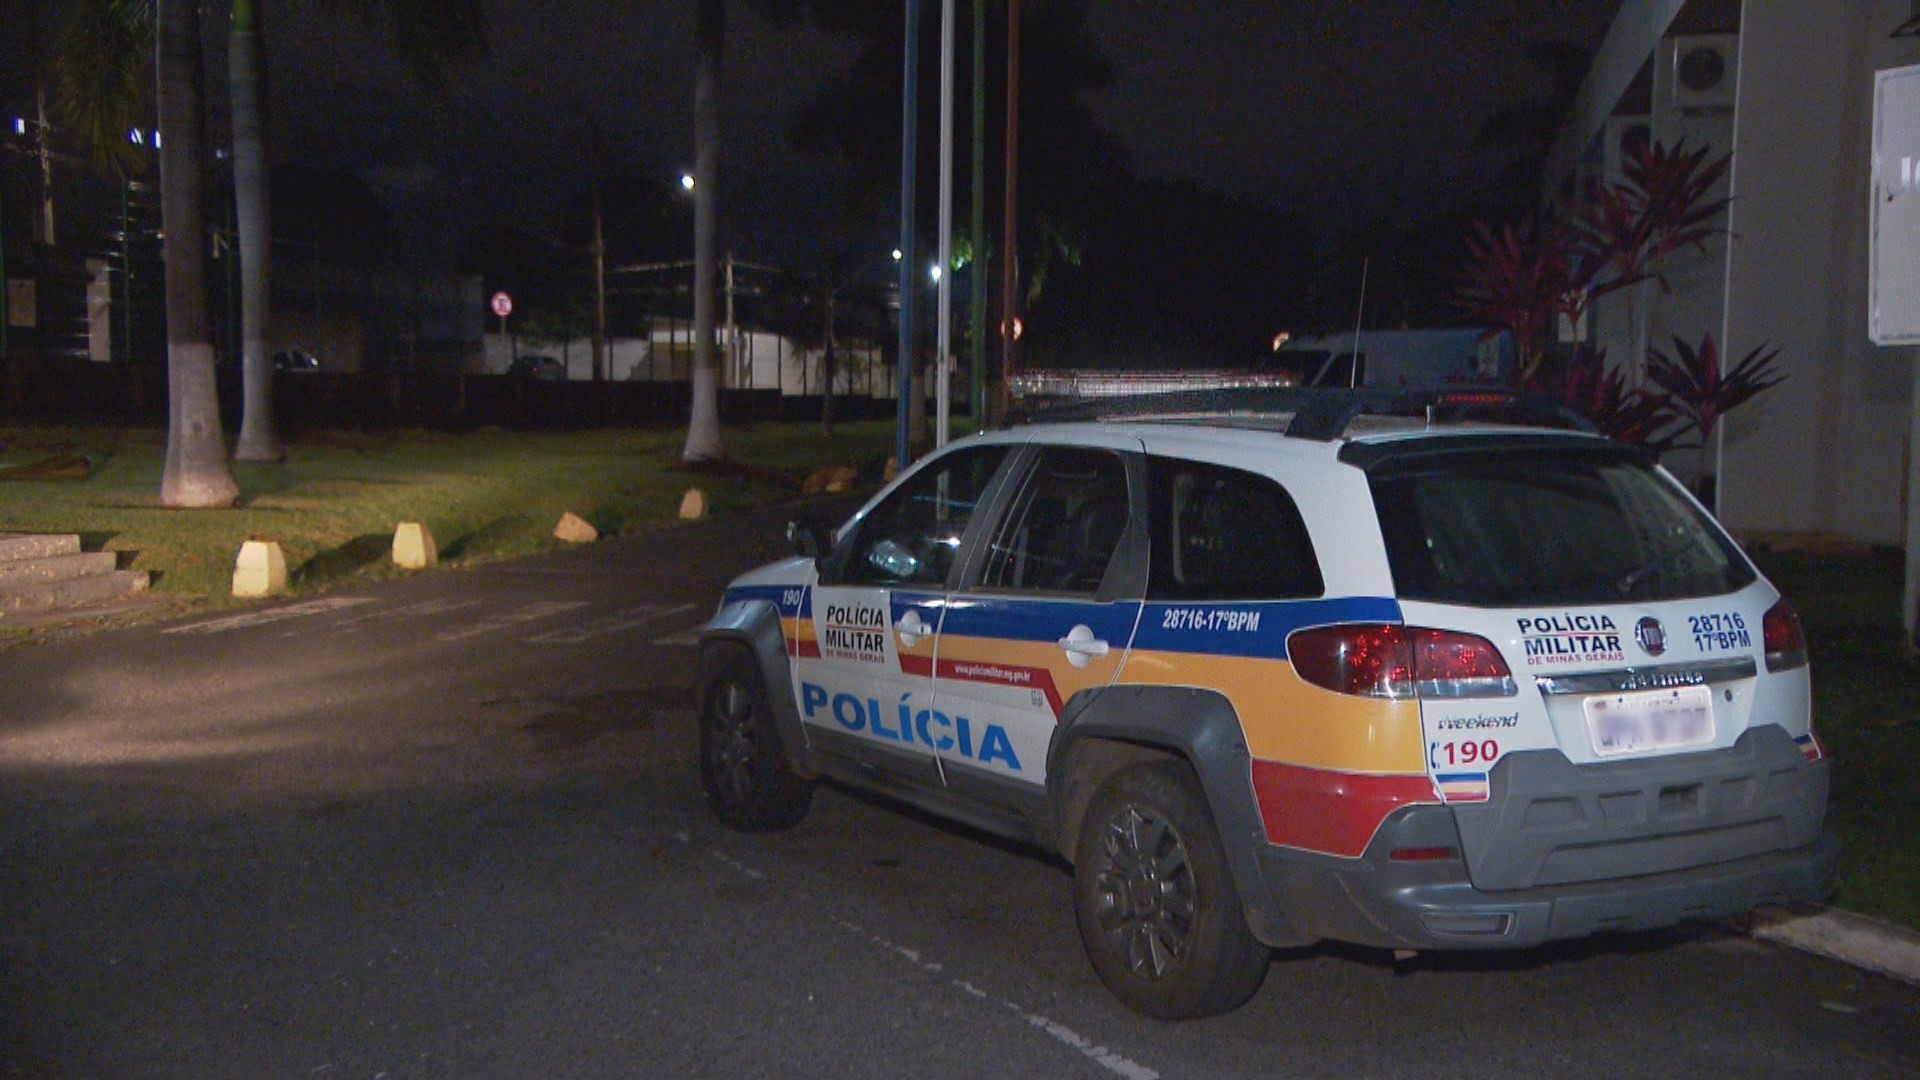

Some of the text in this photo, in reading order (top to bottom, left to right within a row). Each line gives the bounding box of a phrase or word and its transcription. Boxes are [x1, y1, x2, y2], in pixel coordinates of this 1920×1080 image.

[783, 590, 800, 605] 190
[827, 602, 884, 627] POLÍCIA
[1517, 613, 1616, 634] POLÍCIA
[1688, 612, 1744, 633] 28716
[825, 630, 883, 653] MILITAR
[1524, 636, 1622, 655] MILITAR
[859, 652, 885, 664] GERAIS
[1527, 652, 1625, 665] DE MINAS GERAIS
[802, 682, 1022, 771] POLÍCIA
[1443, 740, 1498, 765] 190
